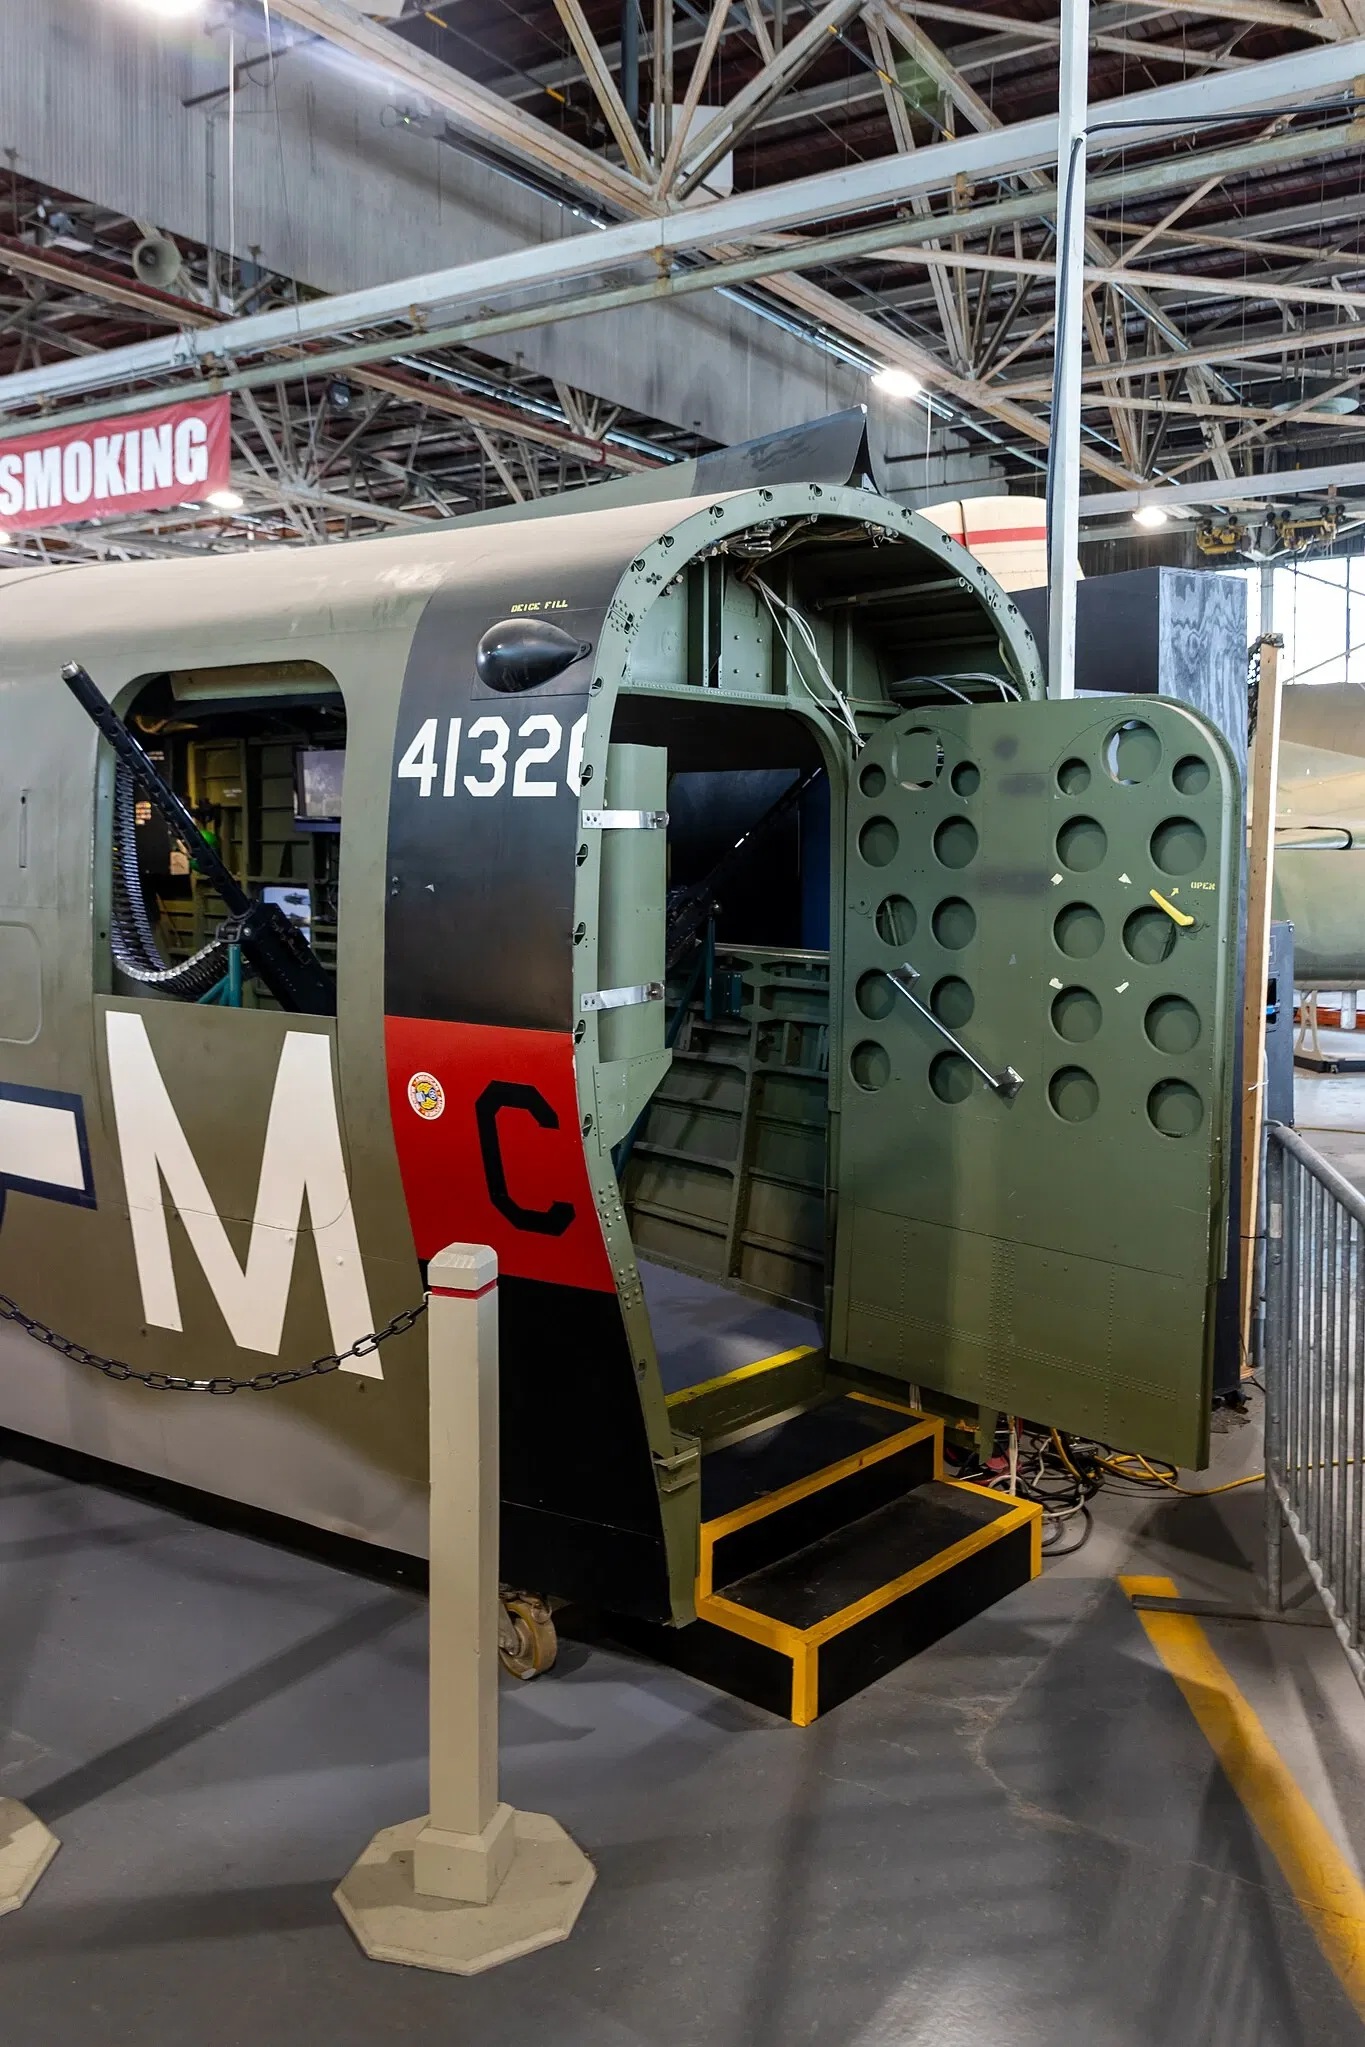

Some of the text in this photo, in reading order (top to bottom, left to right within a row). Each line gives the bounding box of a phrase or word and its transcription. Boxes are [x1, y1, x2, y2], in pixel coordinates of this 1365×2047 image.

[0, 417, 208, 516] SMOKING
[544, 600, 569, 609] FILL
[1190, 881, 1216, 891] OPEN
[105, 1010, 384, 1380] M
[475, 1079, 576, 1237] C
